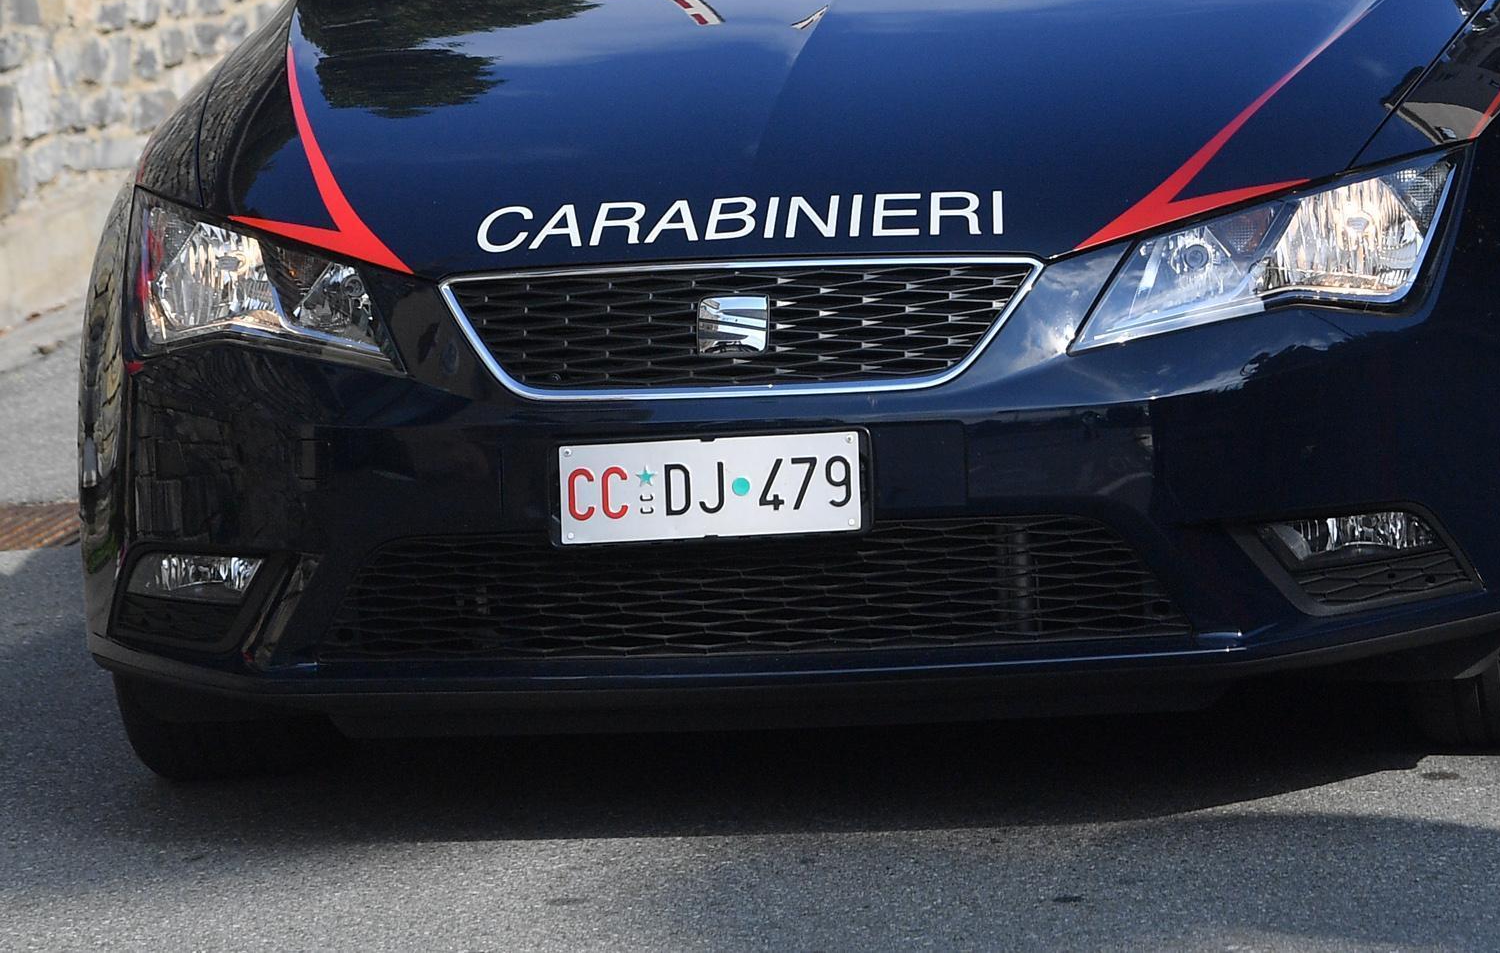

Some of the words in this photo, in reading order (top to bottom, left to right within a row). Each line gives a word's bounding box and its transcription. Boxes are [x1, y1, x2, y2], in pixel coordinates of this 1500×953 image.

[475, 190, 1004, 253] CARABINIERI
[567, 465, 629, 521] CC
[664, 461, 725, 517] DJ
[758, 455, 852, 511] 479
